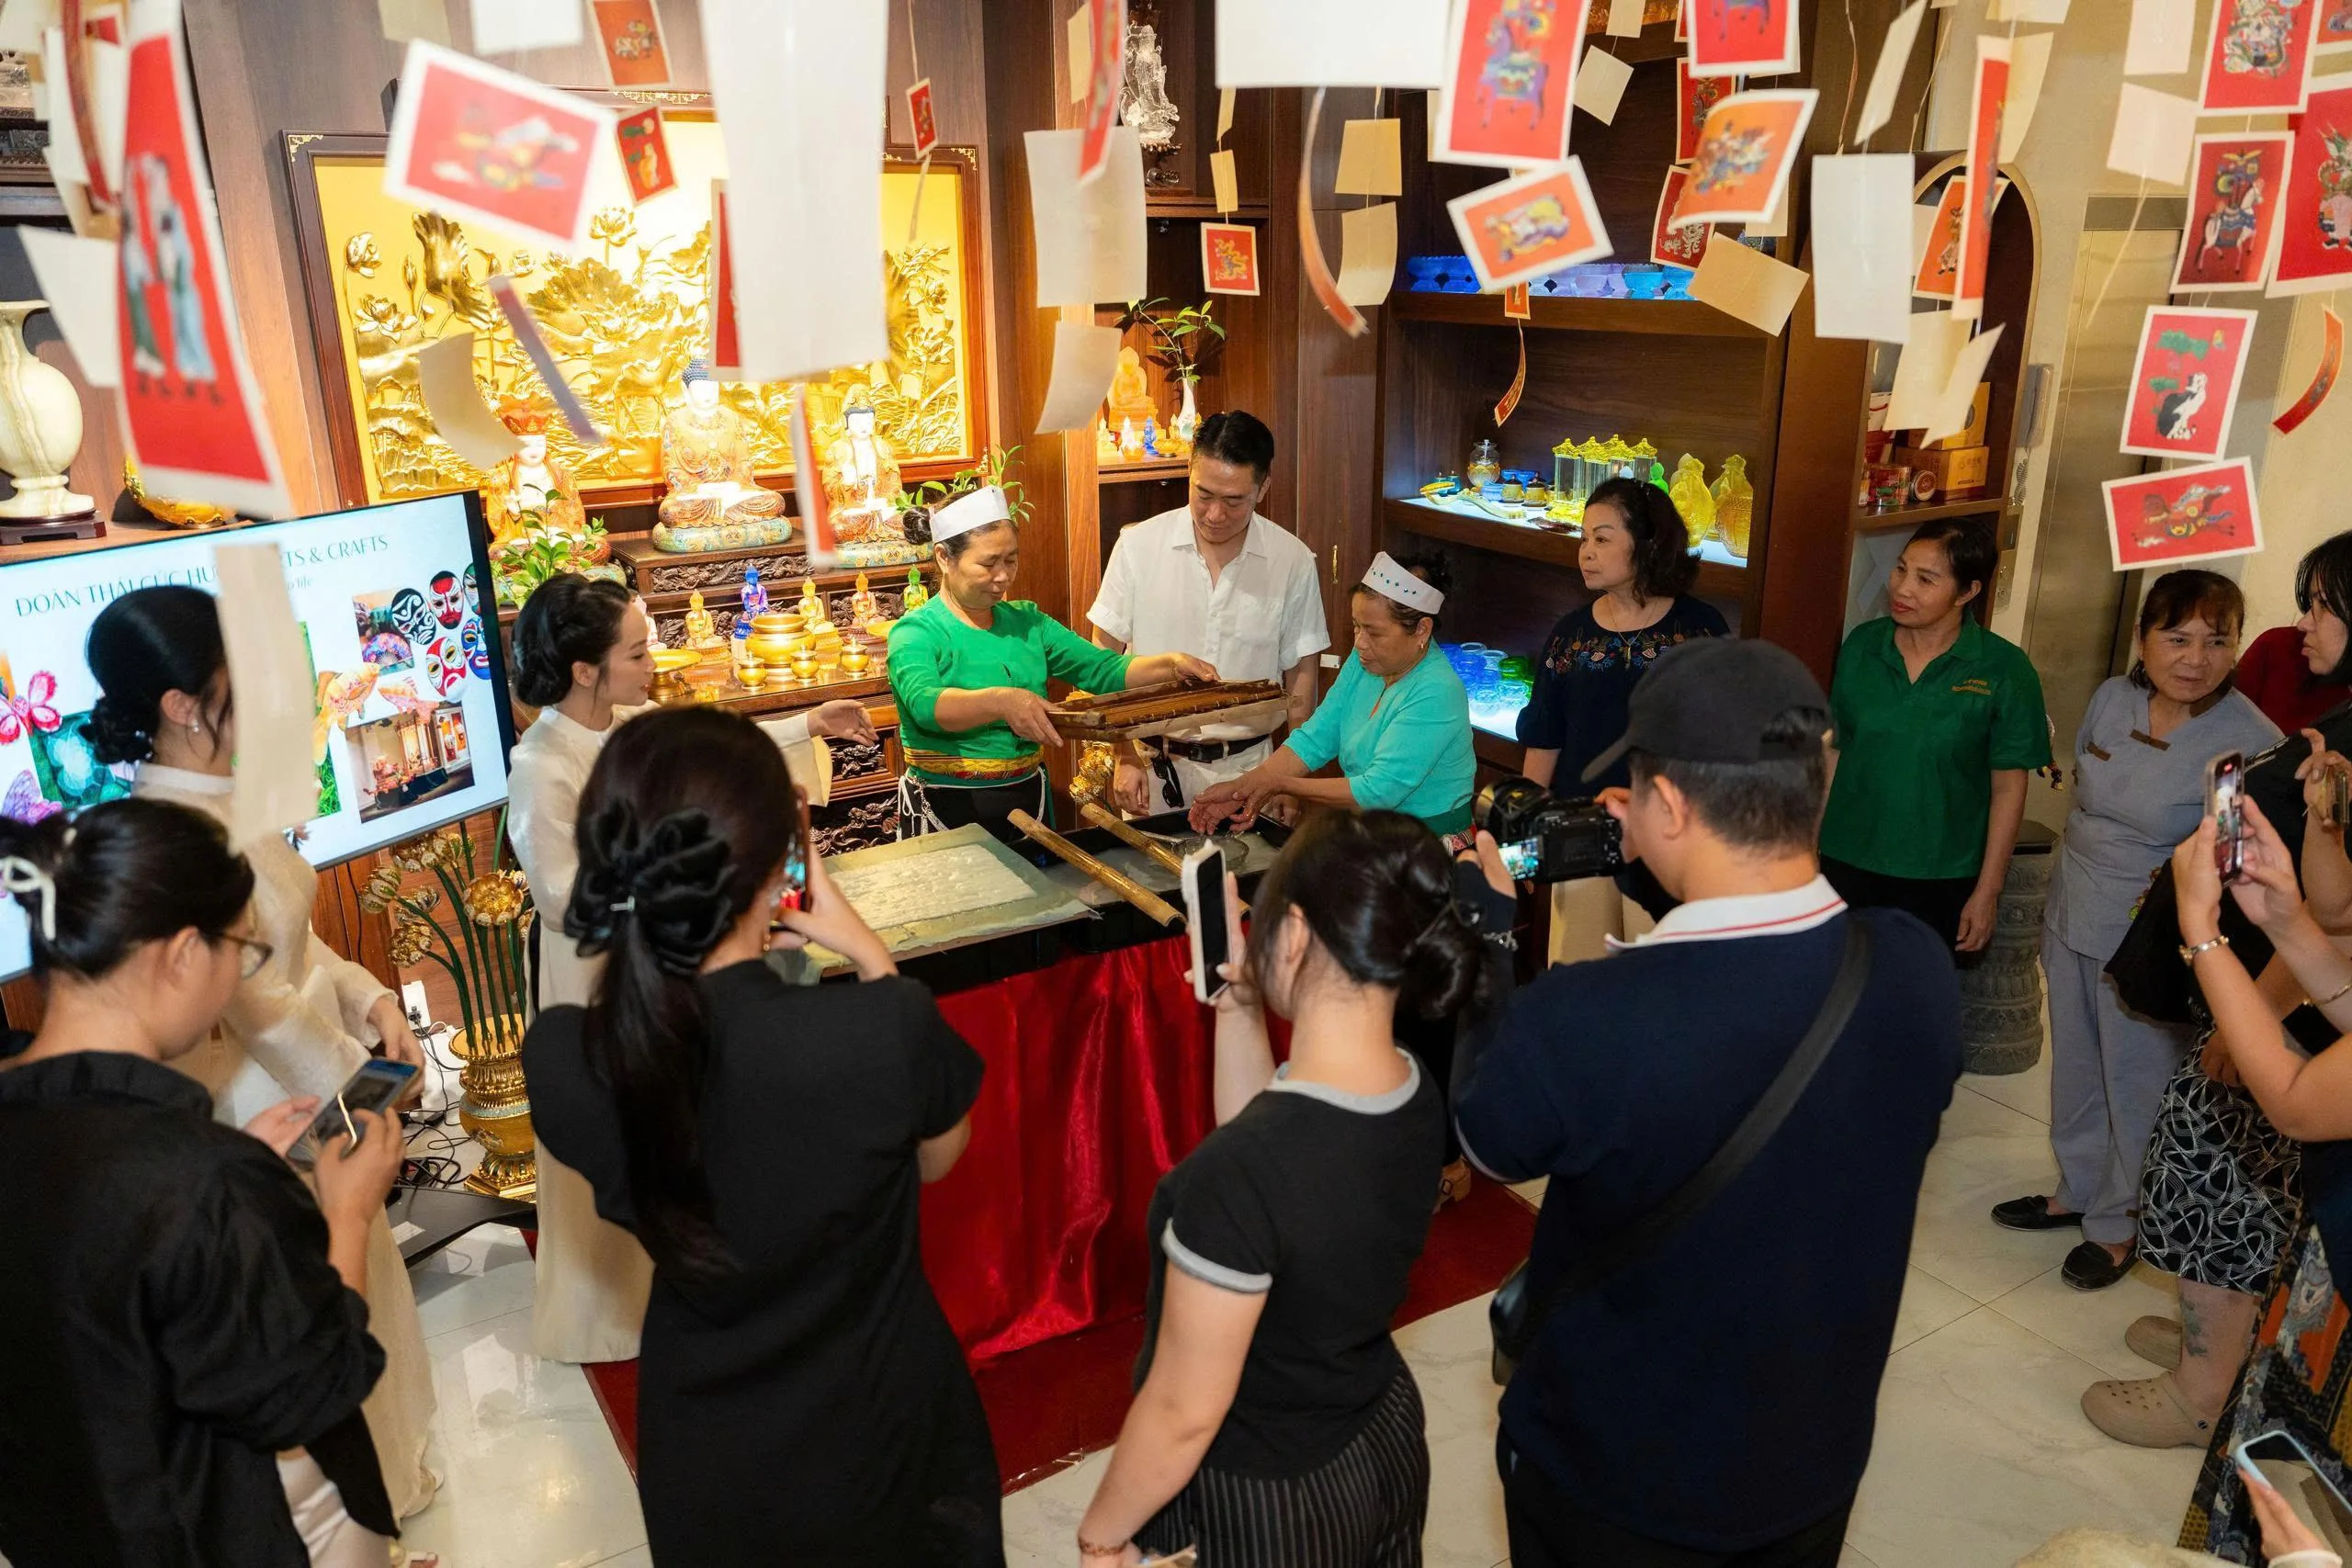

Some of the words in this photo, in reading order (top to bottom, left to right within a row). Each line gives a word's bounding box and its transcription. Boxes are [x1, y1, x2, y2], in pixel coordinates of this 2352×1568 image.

[283, 549, 306, 567] TS
[310, 546, 324, 564] &
[326, 534, 389, 561] CRAFTS
